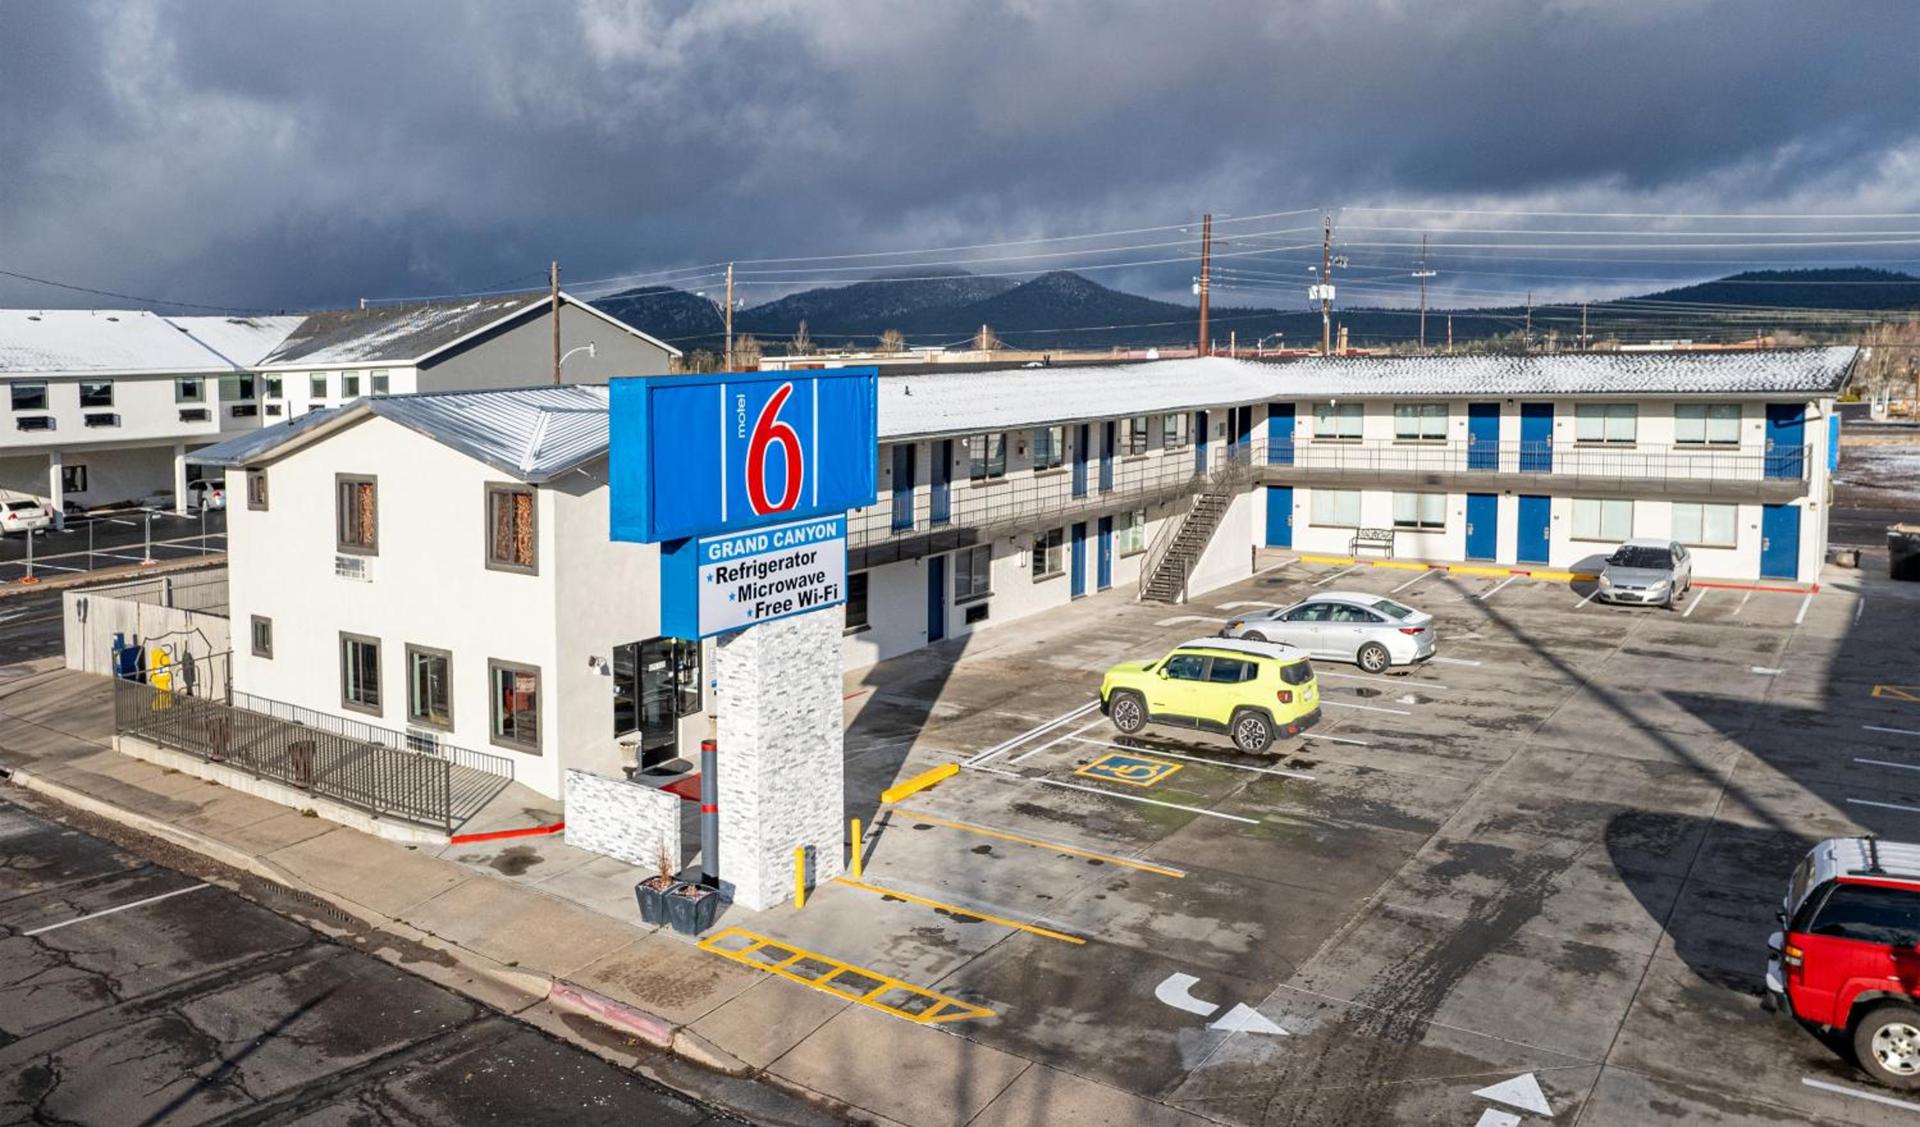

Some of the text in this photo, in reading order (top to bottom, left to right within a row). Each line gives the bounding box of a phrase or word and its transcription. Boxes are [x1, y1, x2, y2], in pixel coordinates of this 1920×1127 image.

[736, 394, 746, 439] motel
[745, 381, 804, 517] 6
[708, 521, 837, 561] GRAND CANYON
[715, 549, 818, 585] Refrigerator
[737, 569, 826, 603] Microwave
[754, 583, 839, 619] Free Wi-Fi
